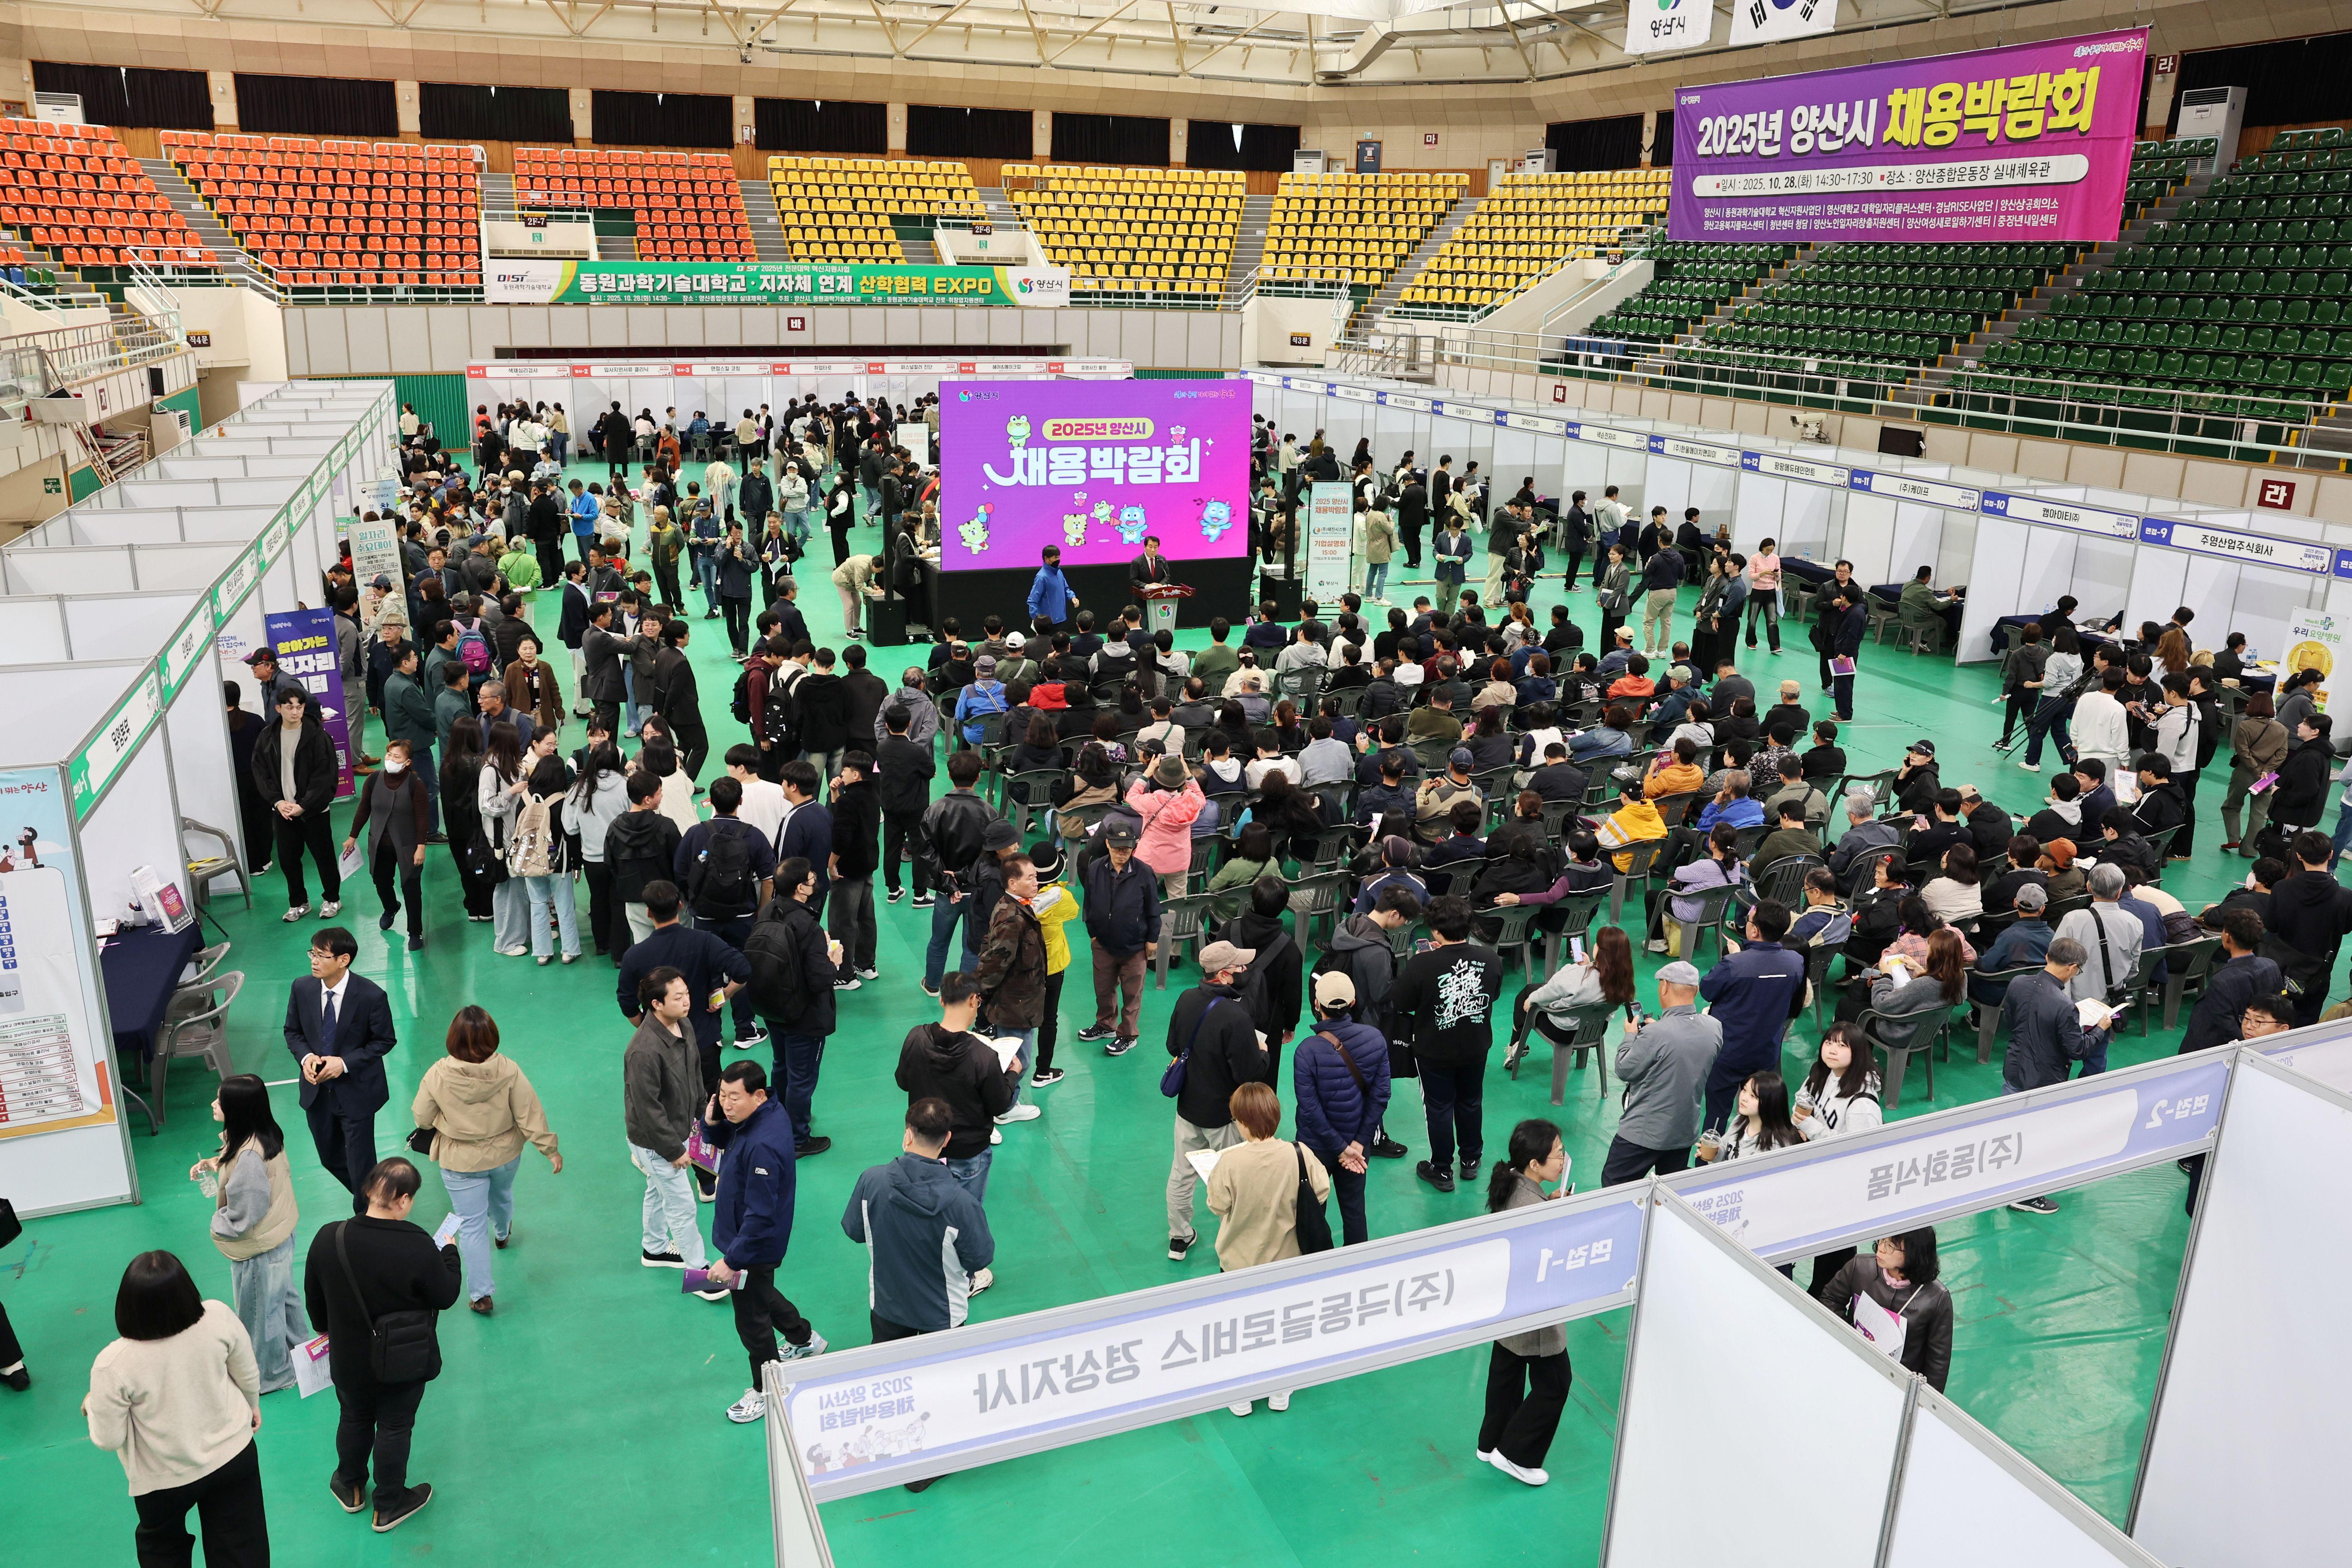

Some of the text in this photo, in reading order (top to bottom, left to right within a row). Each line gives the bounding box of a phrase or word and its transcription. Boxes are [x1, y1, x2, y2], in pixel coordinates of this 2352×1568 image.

[1651, 16, 1685, 38] 양산시
[2126, 37, 2144, 52] 양산
[2158, 56, 2174, 72] 라
[1698, 66, 2101, 156] 2025년 양산시 채용박람회
[1426, 134, 1436, 144] 마
[1887, 161, 2051, 185] 장소 양산종합운동장 실내체육관
[1721, 171, 1873, 192] 일시 2025. 10. 28.(화) 14:30~17:30
[1704, 207, 1721, 218] 양산시
[1725, 206, 1777, 218] 동원과학기술대학교
[1779, 204, 1821, 216] 혁신지원사업단
[1827, 202, 1860, 216] 영산대학교
[2000, 198, 2059, 212] 양산상공회의소
[527, 217, 545, 226] 2F-7
[1704, 214, 2058, 231] 양산고용복지플러스센터 청년센터 청담 양산노인일자리창출지원센터 양산여성새로일하기센터 중장년내일센터
[975, 225, 991, 234] 2F-6
[1608, 254, 1620, 263] 2F-5
[818, 275, 853, 294] 연계
[859, 275, 927, 294] 산학협력
[934, 278, 992, 294] EXPO
[1037, 279, 1063, 289] 양산시
[790, 318, 802, 330] 바
[189, 335, 209, 344] 직4문
[1292, 336, 1308, 344] 직3문
[99, 390, 106, 407] 가
[973, 391, 999, 400] 양산시
[1218, 388, 1236, 399] 양산
[1554, 387, 1565, 401] 마
[1052, 421, 1146, 436] 2025년 양산시
[1650, 440, 1663, 449] 면접-13
[982, 437, 1200, 487] 채용박람회
[1743, 458, 1758, 467] 면접-12
[1853, 476, 1870, 487] 면접-11
[1899, 483, 1929, 497] (주)케이프
[2263, 485, 2288, 505] 라
[1315, 506, 1348, 514] 채용박람회
[1984, 499, 2006, 510] 면접-10
[359, 529, 386, 541] 일자리
[2145, 526, 2168, 538] 면접-9
[356, 540, 392, 553] 수요데이
[2200, 535, 2274, 557] 주영산업주식회사
[2293, 627, 2341, 643] 우리 요양병원
[182, 631, 194, 660] 인생네컷
[277, 635, 328, 655] 찾아가는
[277, 651, 336, 676] 일자리
[21, 782, 48, 793] 양산
[73, 769, 88, 800] 안내-1
[520, 835, 529, 857] COVER
